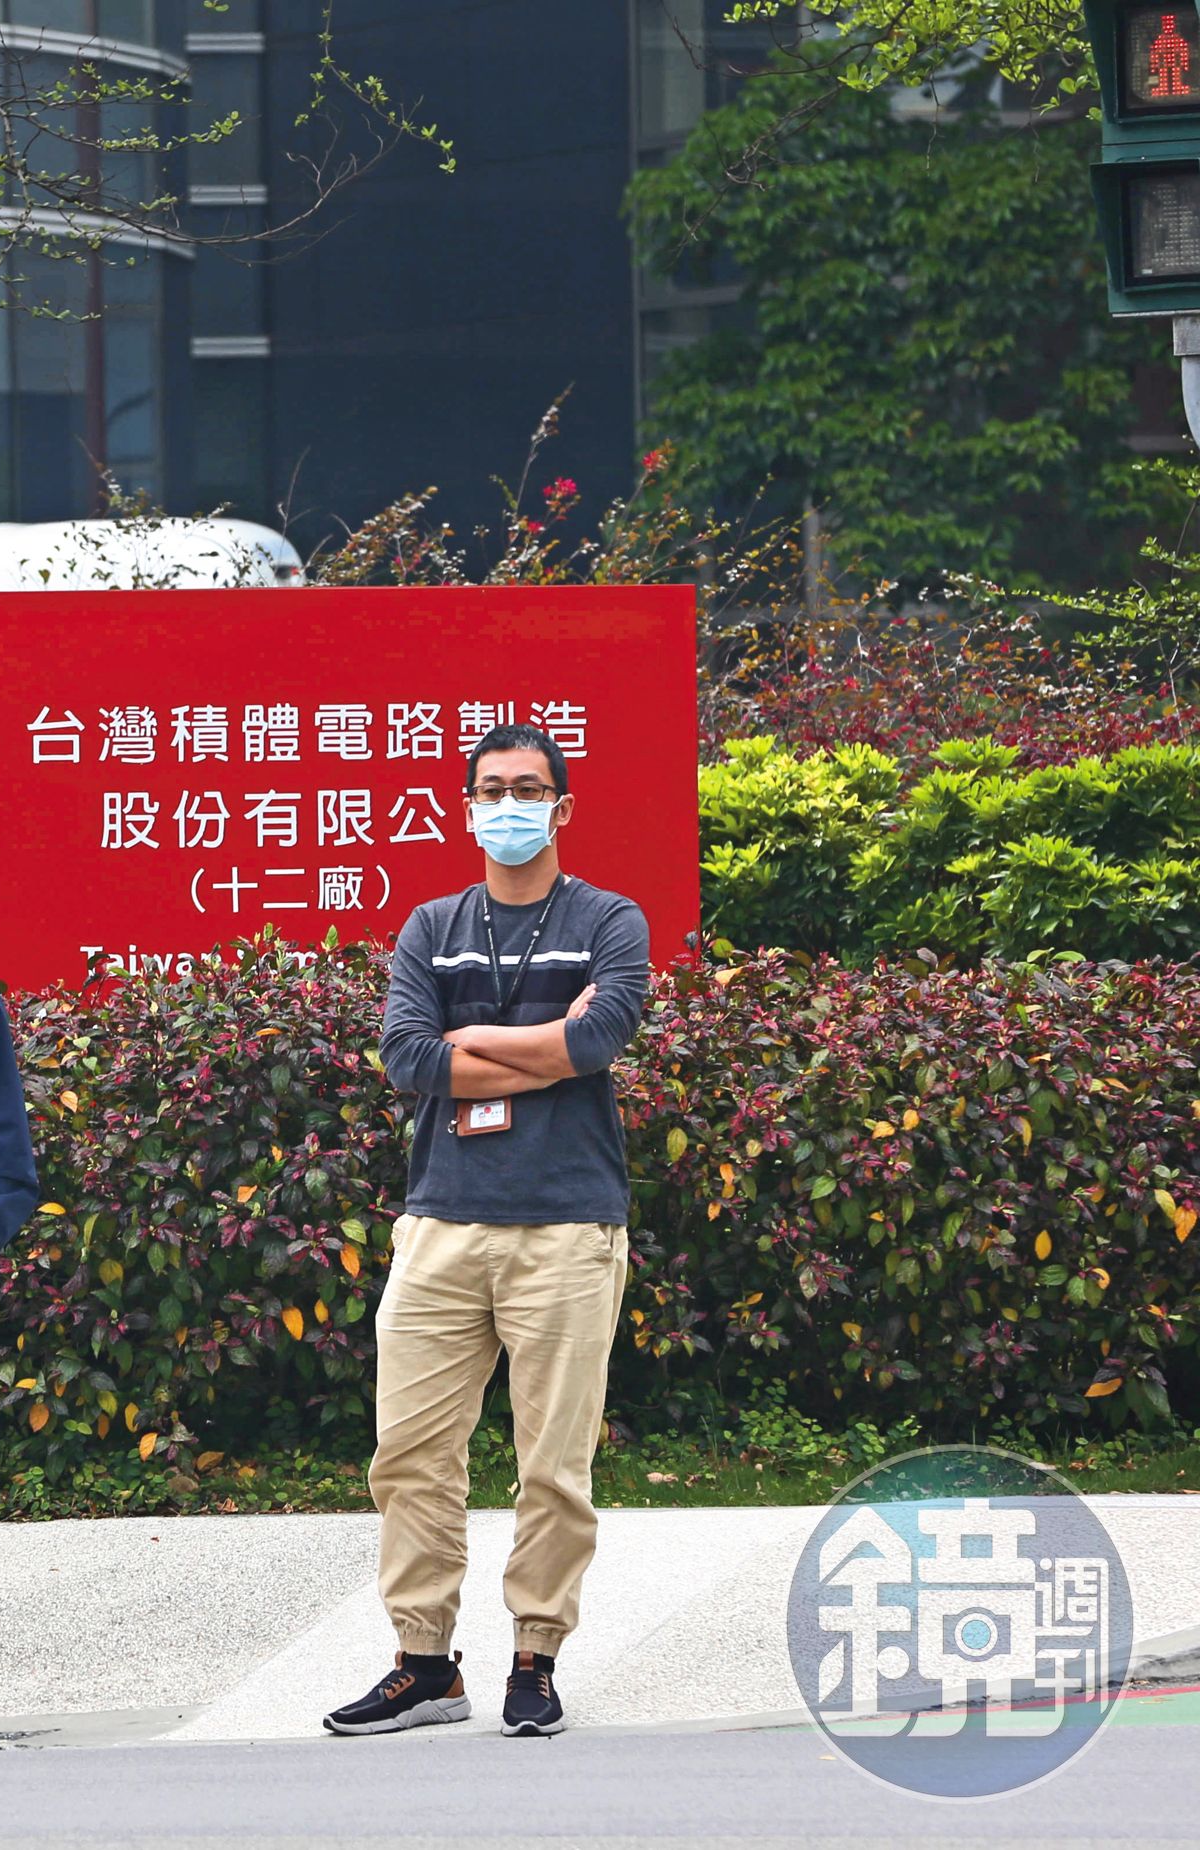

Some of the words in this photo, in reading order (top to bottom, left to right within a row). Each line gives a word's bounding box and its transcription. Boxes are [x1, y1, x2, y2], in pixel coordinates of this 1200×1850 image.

[101, 786, 470, 849] 股份有限公
